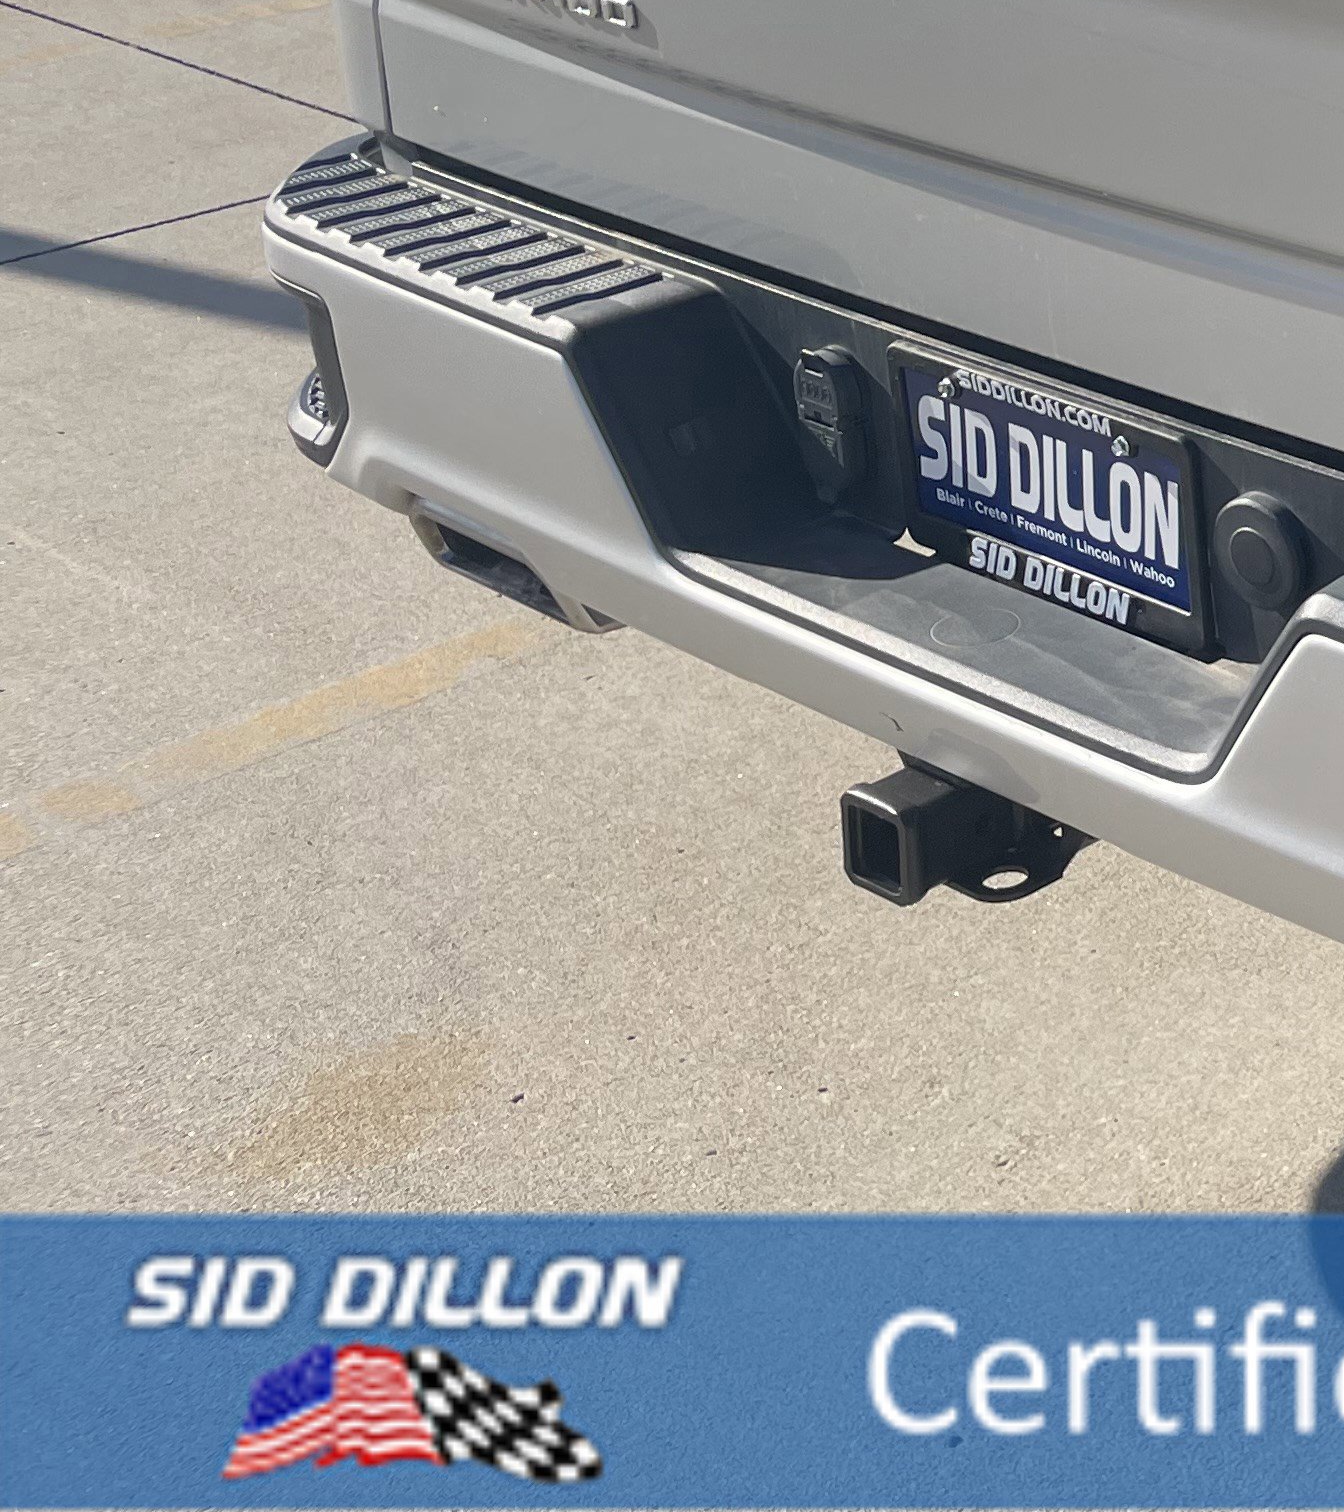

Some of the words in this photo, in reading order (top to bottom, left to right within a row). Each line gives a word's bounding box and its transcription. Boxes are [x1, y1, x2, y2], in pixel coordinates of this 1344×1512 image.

[956, 369, 1112, 437] SIDDILLON.COM
[917, 394, 998, 499] SID
[1008, 425, 1180, 568] DILLON
[936, 487, 966, 510] Blair
[974, 500, 1008, 524] Crete
[1016, 514, 1068, 547] Fremont
[1075, 536, 1121, 567] Lincoln
[1129, 559, 1176, 589] Wahoo
[968, 536, 1017, 581] SID
[1023, 555, 1131, 626] DILLON
